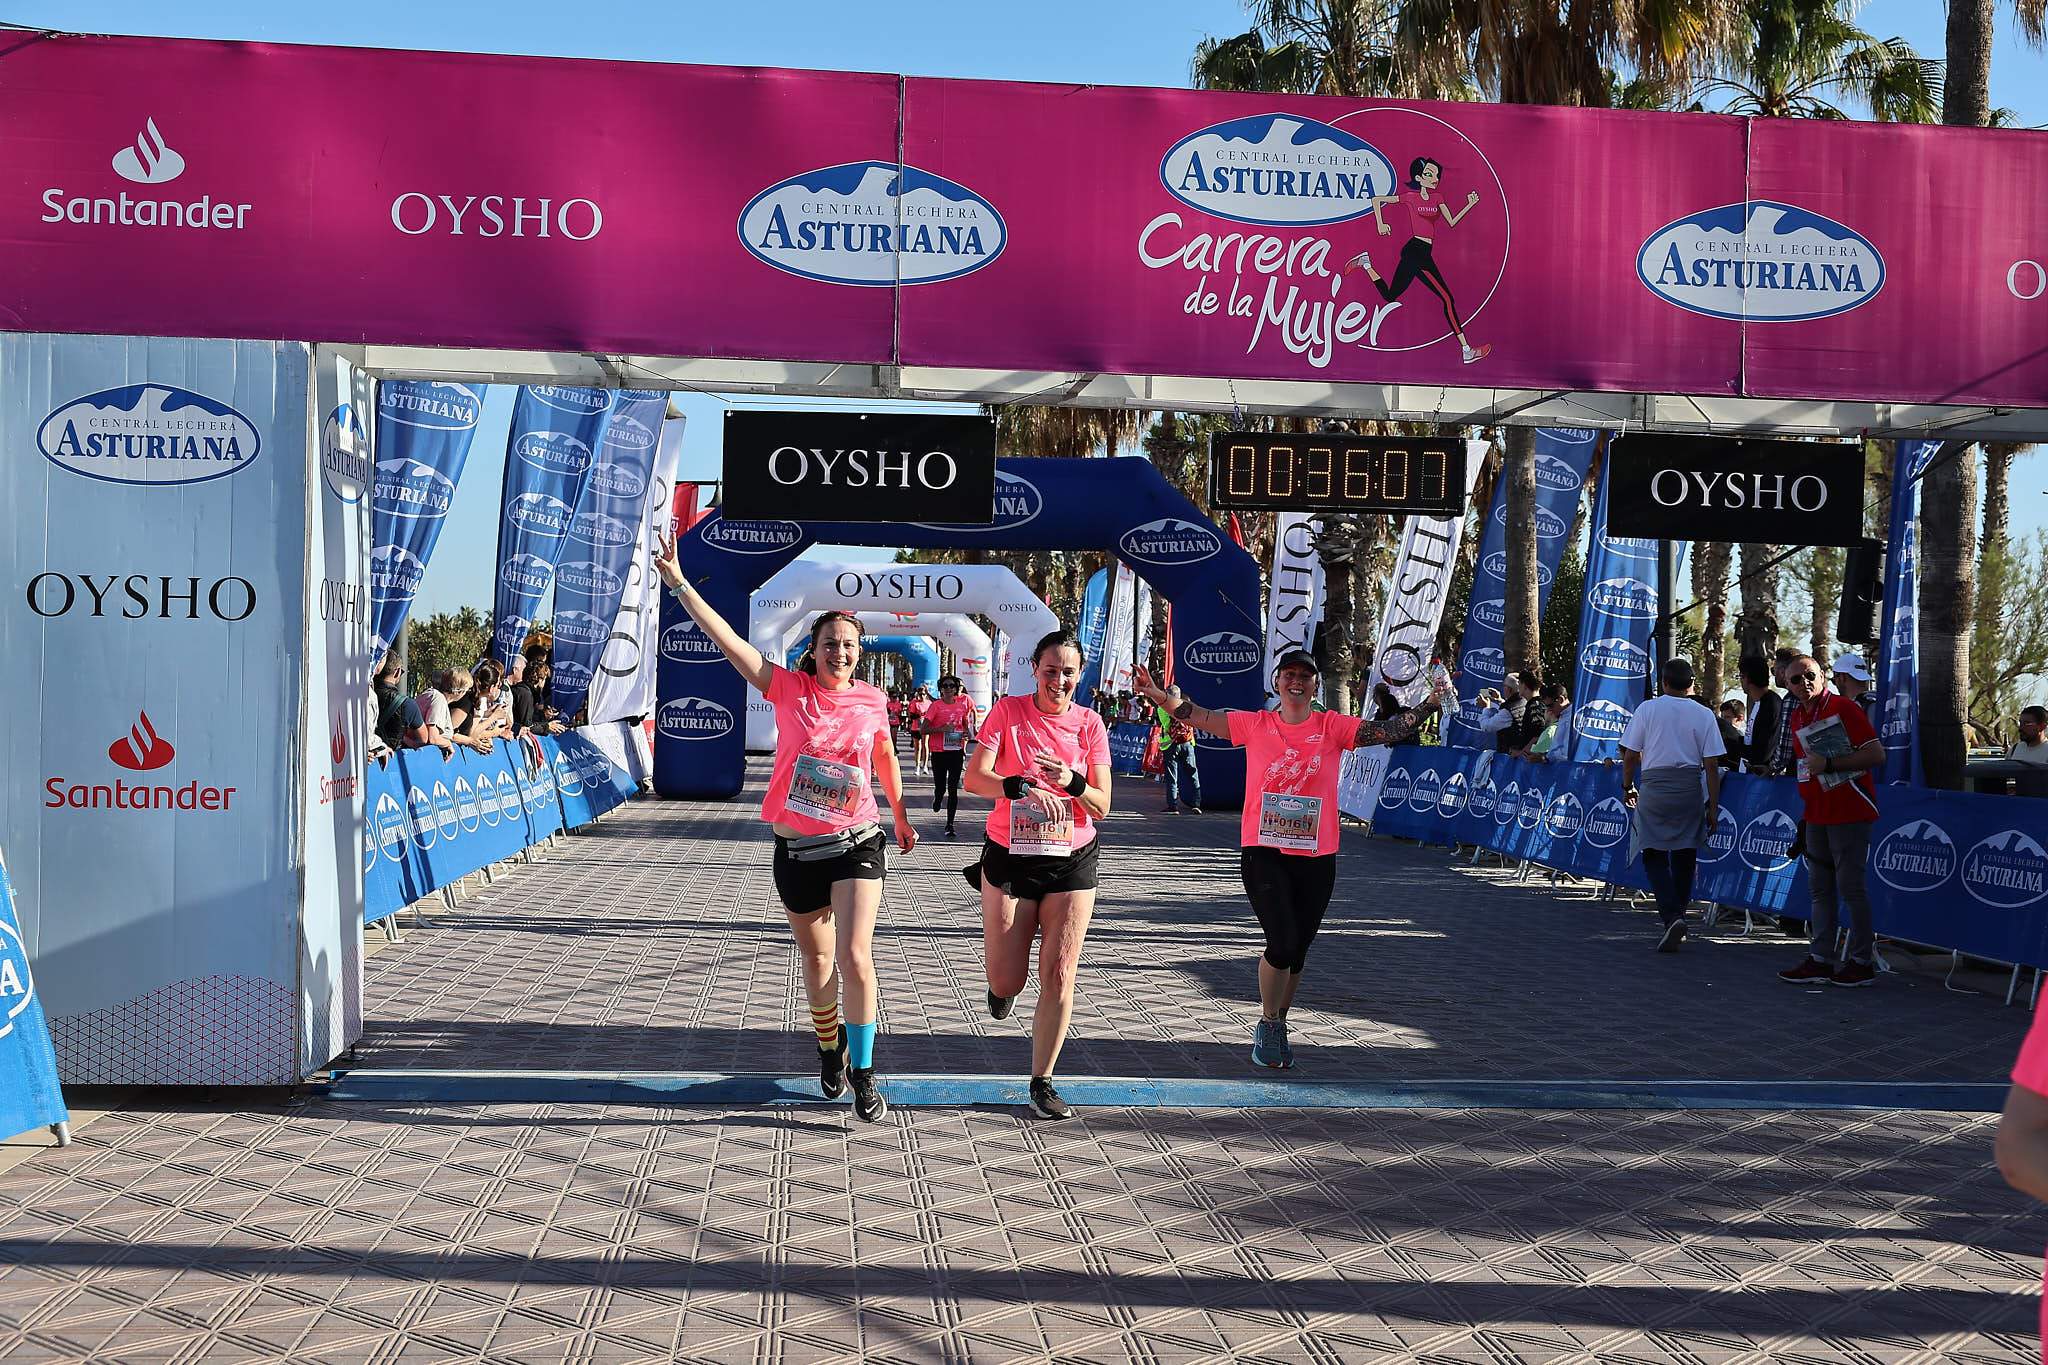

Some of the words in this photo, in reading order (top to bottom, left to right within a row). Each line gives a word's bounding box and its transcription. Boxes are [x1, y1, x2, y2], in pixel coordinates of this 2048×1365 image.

[1216, 149, 1289, 163] CENTRAL
[1297, 154, 1371, 167] LECHERA
[1178, 150, 1377, 200] ASTURIANA
[41, 188, 252, 229] Santander
[391, 191, 603, 241] OYSHO
[801, 202, 884, 216] CENTRAL
[758, 203, 986, 256] ASTURIANA
[1138, 212, 1331, 277] Carrera
[1695, 240, 1772, 255] CENTRAL
[1780, 244, 1859, 258] LECHERA
[1656, 241, 1865, 293] ASTURIANA
[1183, 275, 1220, 314] de
[1227, 275, 1253, 317] la
[1247, 273, 1402, 368] Mujer
[89, 417, 159, 429] CENTRAL
[167, 420, 237, 431] LECHERA
[607, 429, 649, 446] TURIANA
[54, 419, 243, 460] ASTURIANA
[768, 446, 957, 490] OYSHO
[1229, 446, 1446, 500] 00:36:07
[374, 483, 448, 511] STURIANA
[996, 485, 1025, 493] HERA
[1650, 469, 1828, 512] OYSHO
[707, 524, 794, 543] ASTURIANA
[1129, 537, 1215, 554] ASTURIANA
[372, 572, 420, 594] TURIANA
[557, 568, 615, 591] ASTURIANA
[835, 572, 963, 600] OYSHO
[26, 572, 257, 621] OYSHO
[320, 578, 365, 625] OYSHO
[757, 600, 797, 610] OYSHO
[999, 603, 1037, 613] OYSHO
[1380, 515, 1452, 687] OYSH
[556, 624, 604, 640] STURIANA
[664, 635, 721, 653] ASTURIA
[1189, 648, 1257, 664] ASTURIANA
[660, 712, 728, 730] ASTURIANA
[46, 777, 236, 810] Santander
[1742, 830, 1790, 857] ASTURIAN
[1878, 843, 1948, 877] ASTURIANA
[1966, 853, 2043, 893] ASTURIANA
